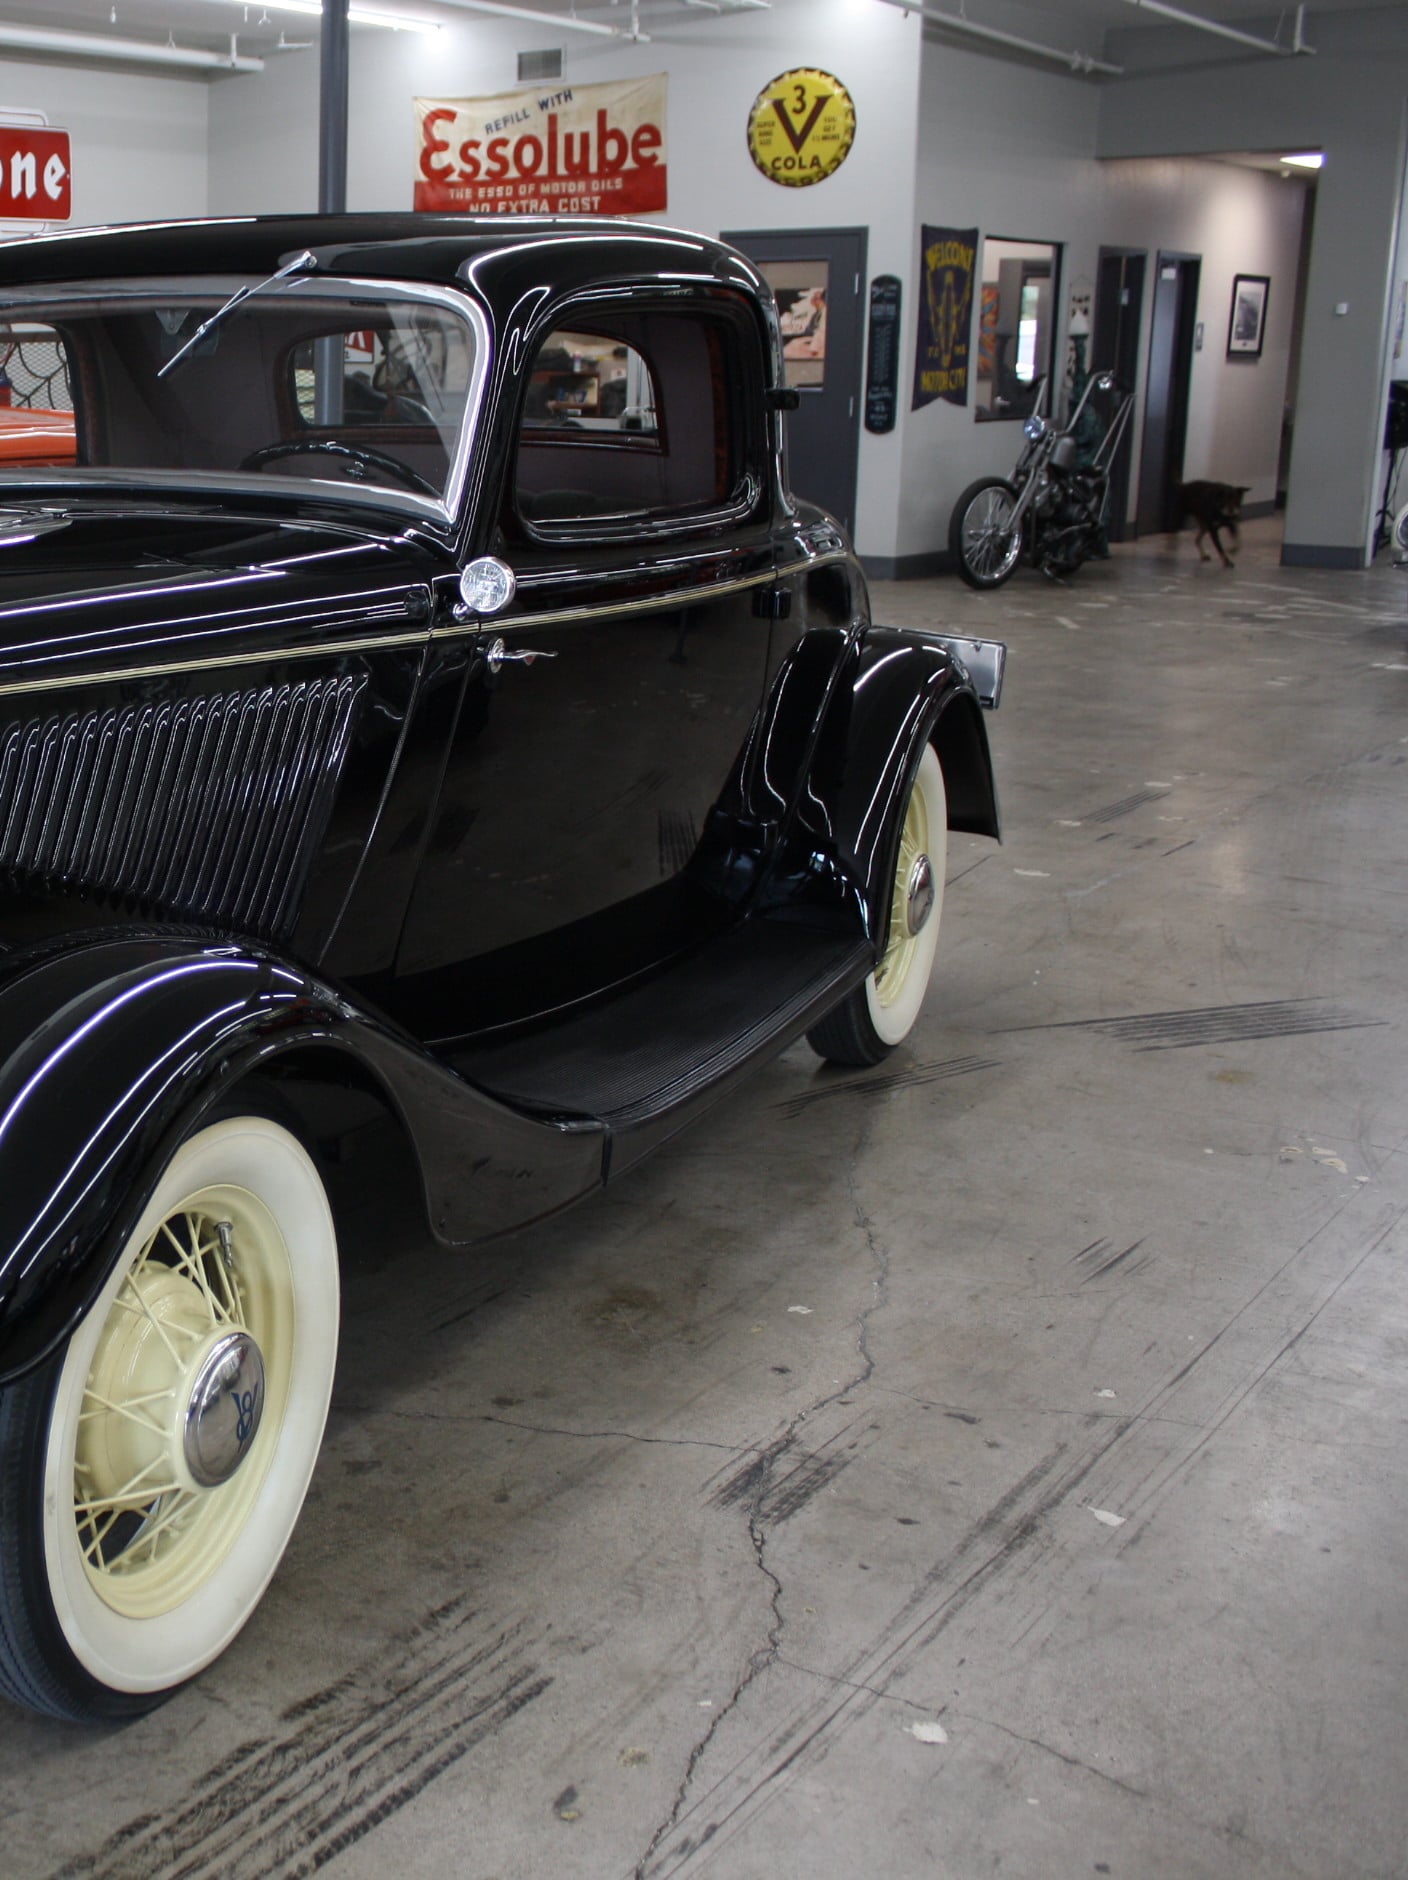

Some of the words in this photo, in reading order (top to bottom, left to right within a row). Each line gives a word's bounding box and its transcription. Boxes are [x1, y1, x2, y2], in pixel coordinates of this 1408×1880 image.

[484, 108, 531, 135] REFILL
[537, 88, 574, 111] WITH
[792, 84, 807, 114] 3
[769, 94, 835, 155] V
[419, 108, 663, 182] Essolube
[771, 154, 823, 171] COLA
[448, 187, 472, 200] THE
[477, 185, 513, 198] ESSO
[518, 183, 536, 196] OF
[540, 180, 586, 195] MOTOR
[592, 177, 624, 191] OILS
[497, 199, 550, 213] EXTRA
[558, 195, 602, 212] COST
